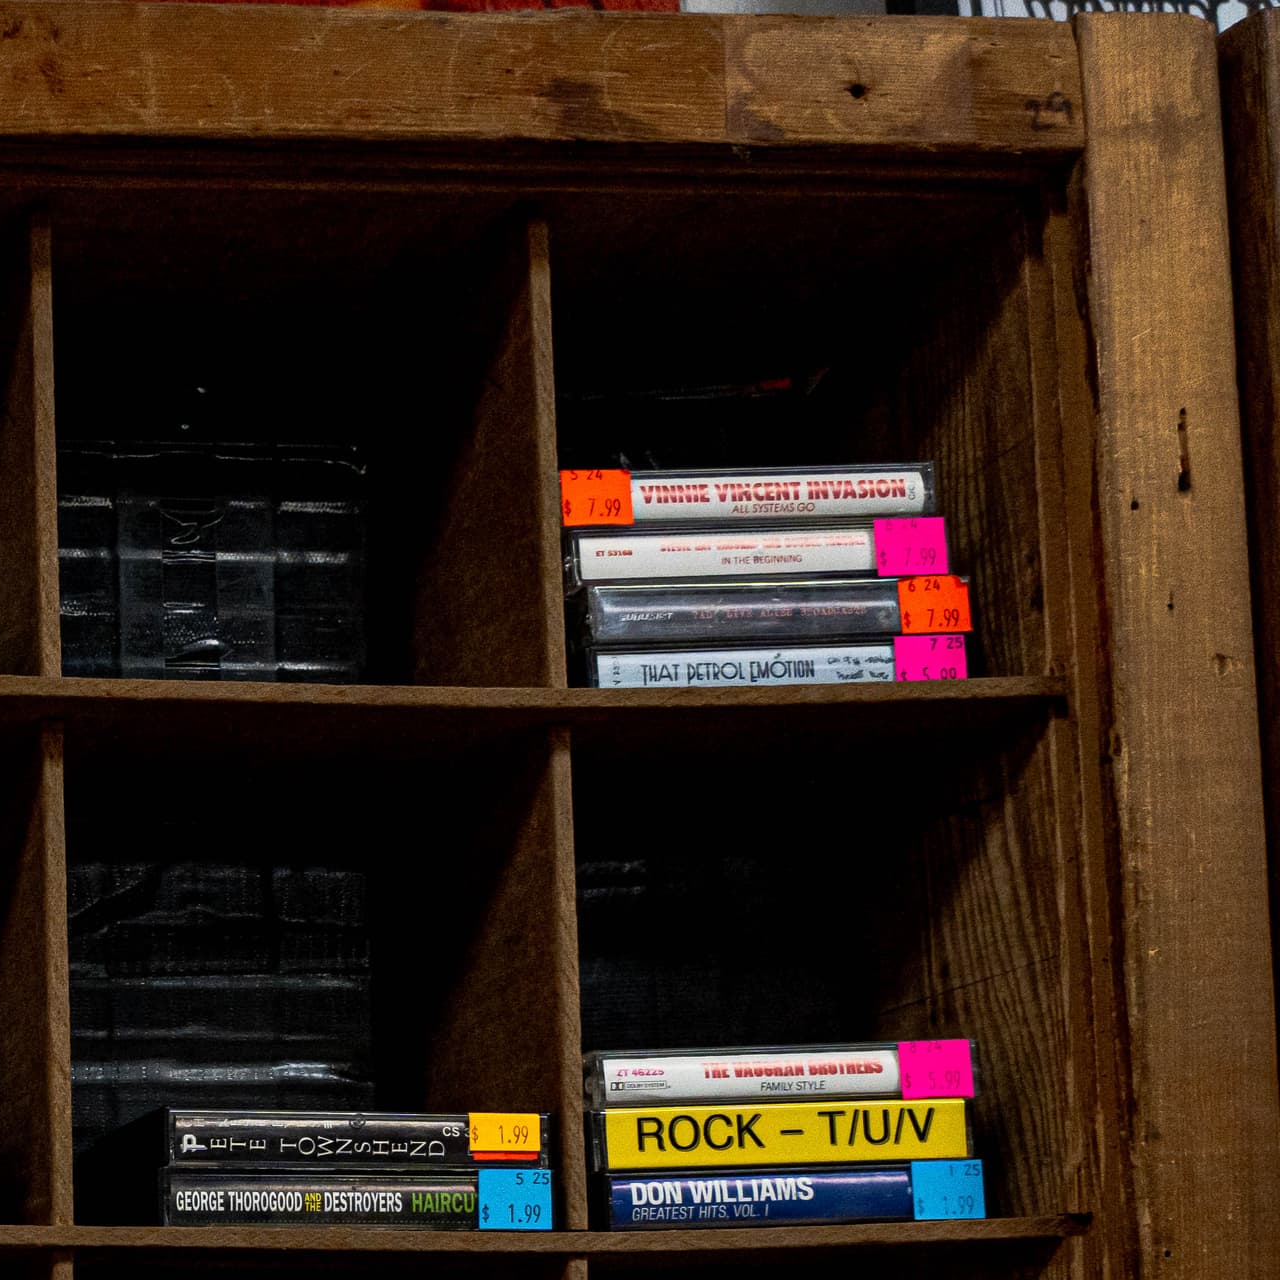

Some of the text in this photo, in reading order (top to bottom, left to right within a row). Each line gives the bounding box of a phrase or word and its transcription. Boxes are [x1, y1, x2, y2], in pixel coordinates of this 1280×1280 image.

[640, 479, 906, 504] VINNIE VINCENT INVASION
[587, 499, 621, 517] 7.99
[732, 502, 815, 514] ALL SYSTEMS GO
[760, 1080, 825, 1092] FAMILY STYLE
[637, 1107, 934, 1152] ROCK T/U/V
[631, 1177, 814, 1206] DON WILLIAMS
[176, 1192, 402, 1212] GEORGE THOROGOOD AND THE DESTROYERS
